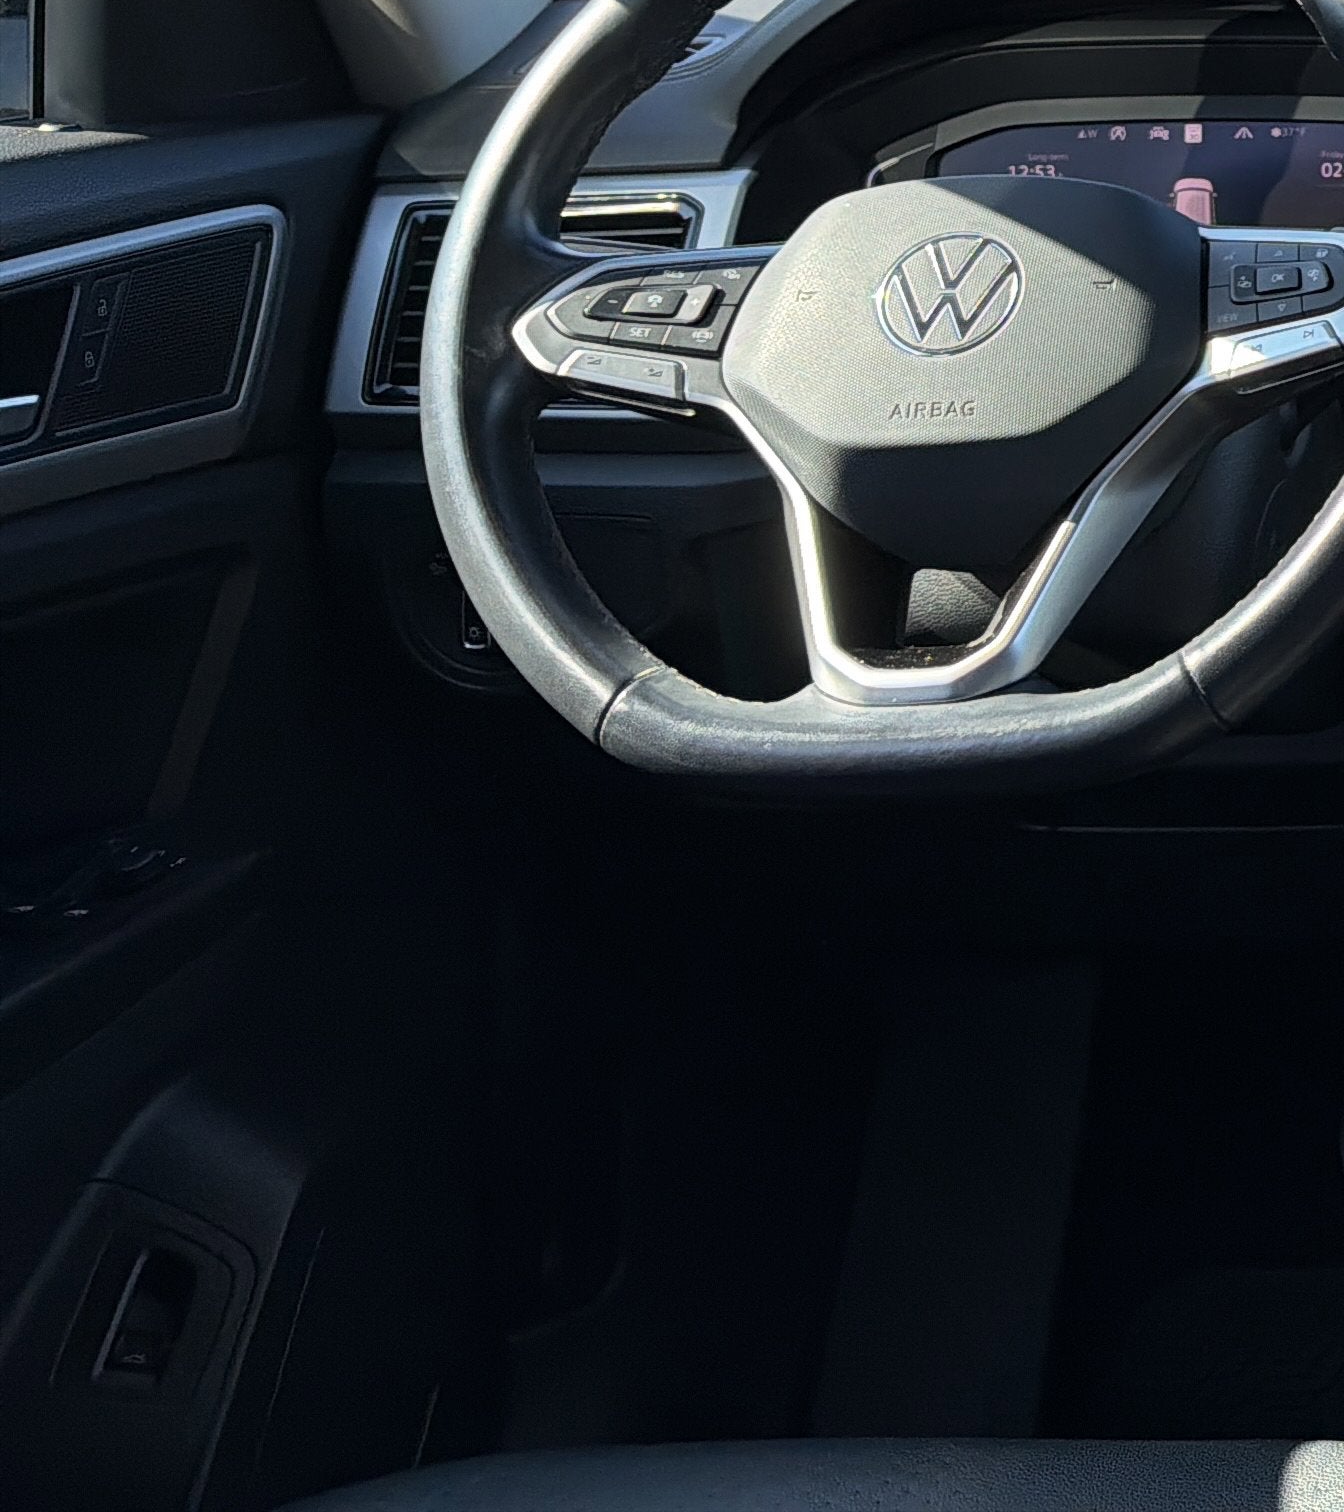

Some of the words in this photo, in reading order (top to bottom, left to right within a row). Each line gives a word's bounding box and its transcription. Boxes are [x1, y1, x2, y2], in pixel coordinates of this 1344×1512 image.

[1271, 273, 1285, 283] OK
[629, 327, 652, 338] SET
[888, 399, 977, 421] AIRBAG
